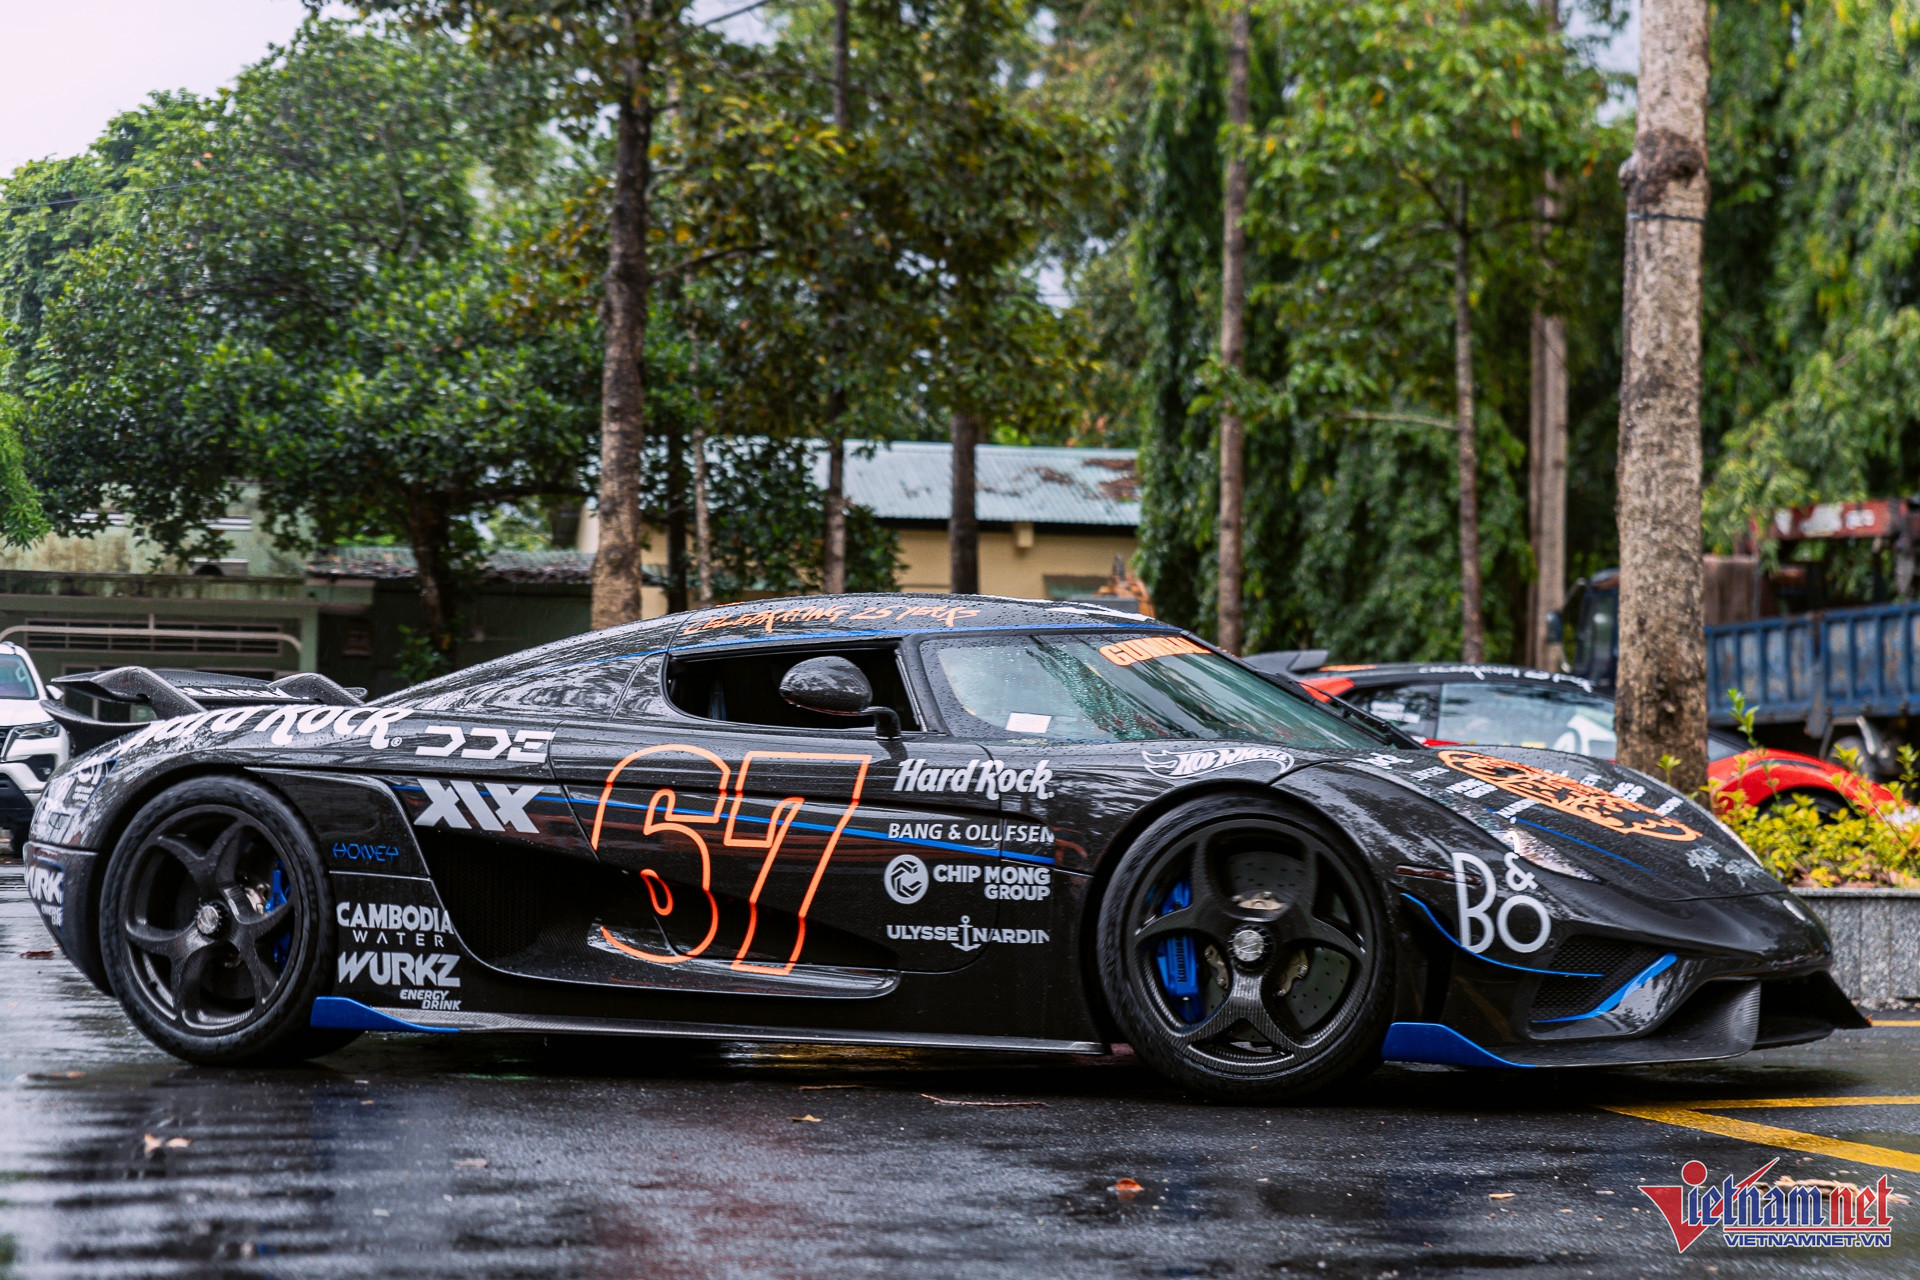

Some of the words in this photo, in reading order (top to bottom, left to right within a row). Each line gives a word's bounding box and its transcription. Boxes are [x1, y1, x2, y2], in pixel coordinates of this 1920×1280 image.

[850, 605, 898, 620] 25
[415, 725, 556, 763] DDE
[893, 758, 980, 792] Hard
[974, 759, 1054, 800] Rock
[413, 778, 544, 833] XIX
[888, 823, 942, 840] BANG
[948, 824, 962, 840] &
[965, 824, 1055, 842] OLUFSEN
[932, 864, 981, 883] CHIP
[984, 866, 1051, 884] MONG
[984, 884, 1051, 901] GROUP
[336, 901, 454, 934] CAMBODIA
[352, 929, 445, 948] WATER
[886, 924, 960, 941] ULYSSE
[972, 927, 1051, 944] NARDIN
[337, 951, 461, 988] WURKZ
[399, 989, 450, 1001] ENERGY
[421, 1000, 462, 1011] DRINK
